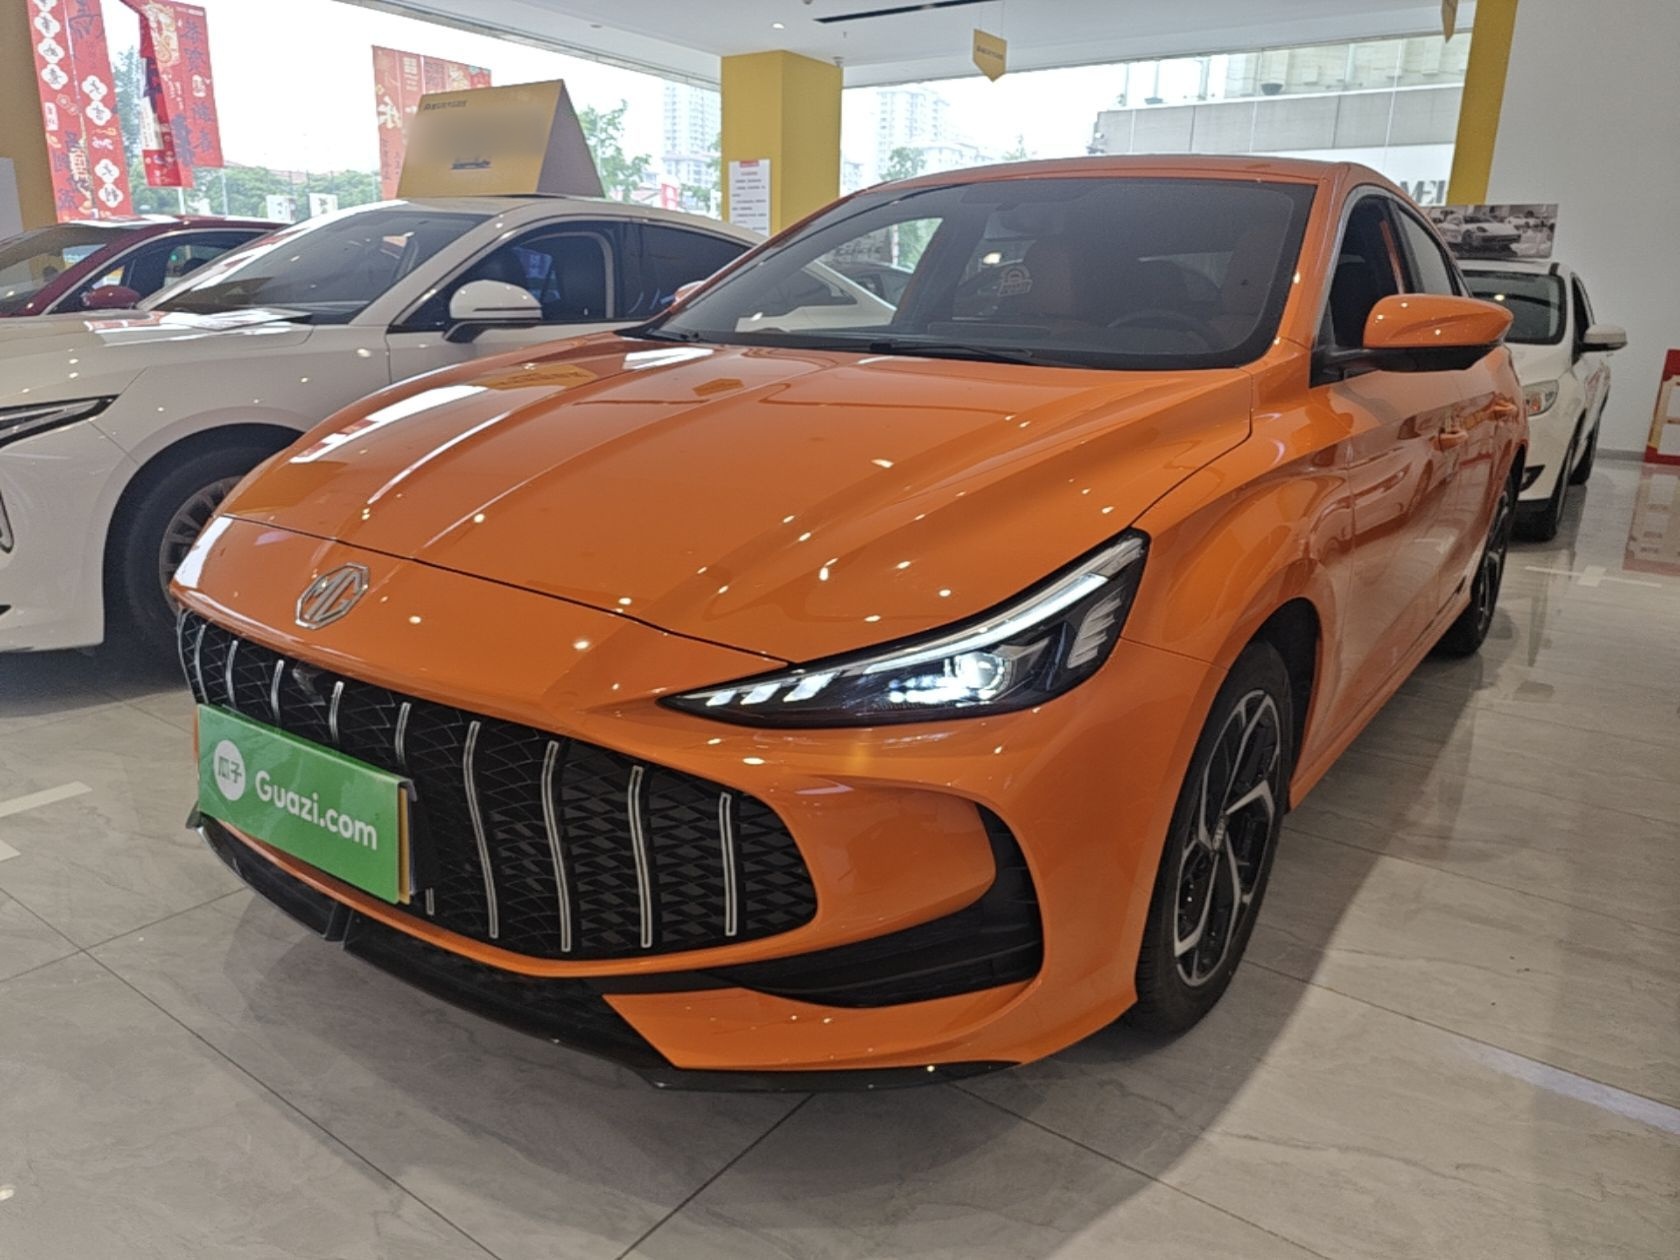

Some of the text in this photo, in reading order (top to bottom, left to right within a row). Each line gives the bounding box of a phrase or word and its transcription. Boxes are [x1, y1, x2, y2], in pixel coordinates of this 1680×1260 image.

[299, 565, 365, 626] MG
[217, 755, 243, 784] 瓜子
[254, 769, 379, 851] Guazi.com
